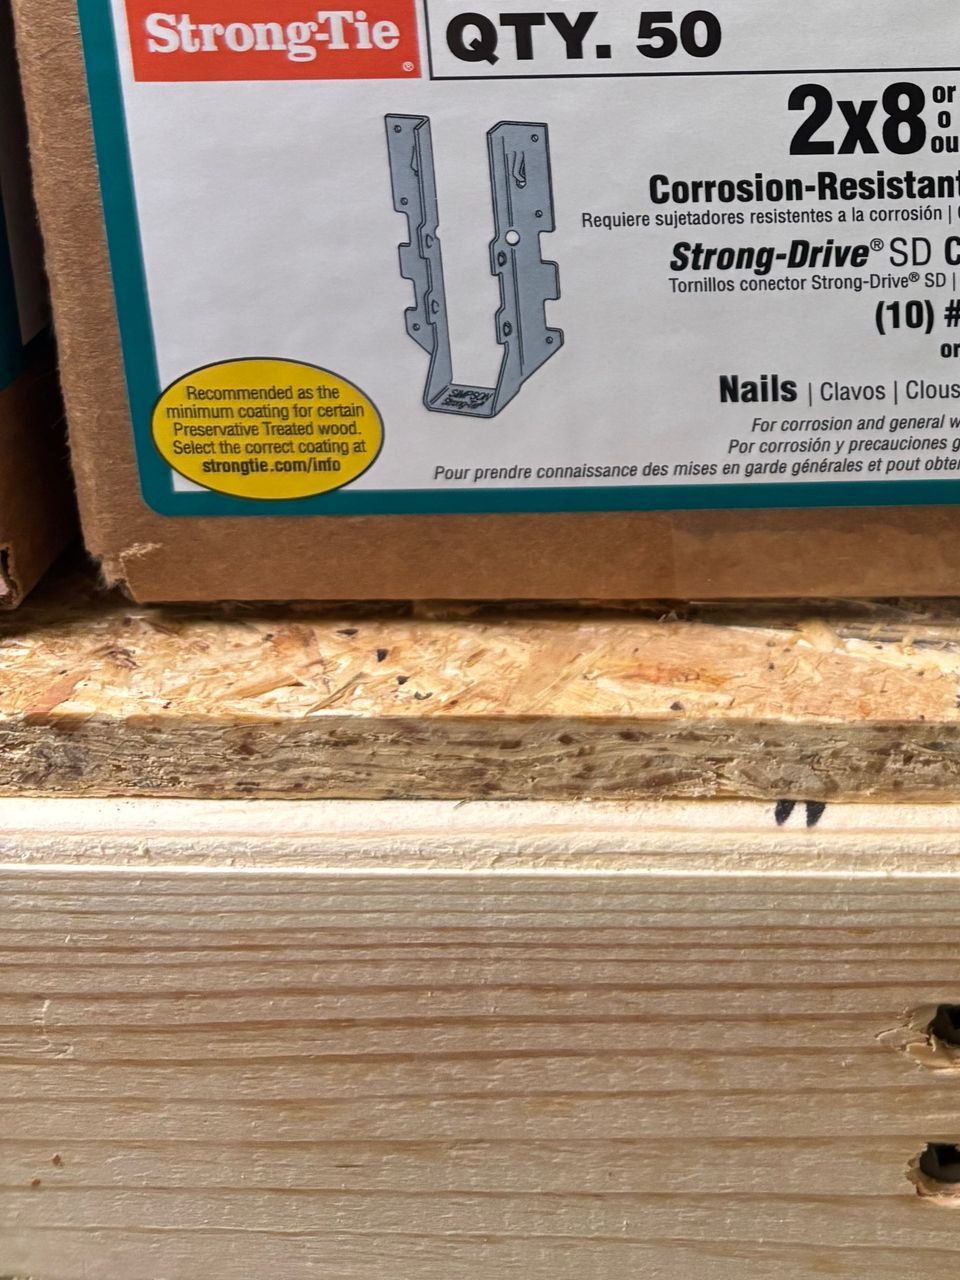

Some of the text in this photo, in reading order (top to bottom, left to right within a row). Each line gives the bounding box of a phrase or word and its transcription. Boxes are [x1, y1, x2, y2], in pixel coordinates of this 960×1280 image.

[145, 10, 400, 62] Strong-Tie
[446, 11, 722, 65] QTY. 50
[788, 82, 926, 155] 2x8
[932, 86, 956, 103] or
[938, 111, 951, 128] o
[931, 136, 959, 153] ou
[582, 210, 650, 230] Requiere
[655, 209, 744, 228] sujetadores
[750, 208, 832, 224] resistentes
[838, 210, 846, 223] a
[852, 206, 864, 222] la
[870, 205, 942, 222] corrosión
[670, 238, 884, 275] Strong-Drive®
[890, 237, 931, 267] SD
[668, 277, 735, 293] Tornillos
[740, 276, 807, 291] conector
[812, 271, 920, 292] Strong-Drive®
[925, 272, 946, 288] SD
[876, 299, 934, 335] (10)
[186, 385, 339, 400] Recommended as the
[720, 374, 797, 403] Nails
[821, 382, 885, 402] Clavos
[166, 404, 364, 420] minimum coating for certain
[174, 421, 361, 436] Preservative Treated wood.
[752, 417, 777, 432] For
[781, 416, 852, 432] corrosion
[857, 415, 885, 431] and
[889, 414, 945, 433] general
[174, 439, 367, 455] Select the correct coating at
[728, 438, 755, 454] Por
[759, 437, 830, 454] corrosión
[834, 440, 845, 455] y
[848, 435, 947, 454] precauciones
[202, 457, 341, 475] strongtie.com/info
[434, 465, 470, 480] Pour
[474, 464, 531, 483] prendre
[537, 463, 637, 479] connaissance
[642, 461, 668, 476] des
[673, 461, 717, 476] mises
[722, 463, 740, 475] en
[745, 459, 787, 478] garde
[792, 457, 863, 477] générales
[868, 458, 882, 472] et
[885, 456, 921, 475] pout
